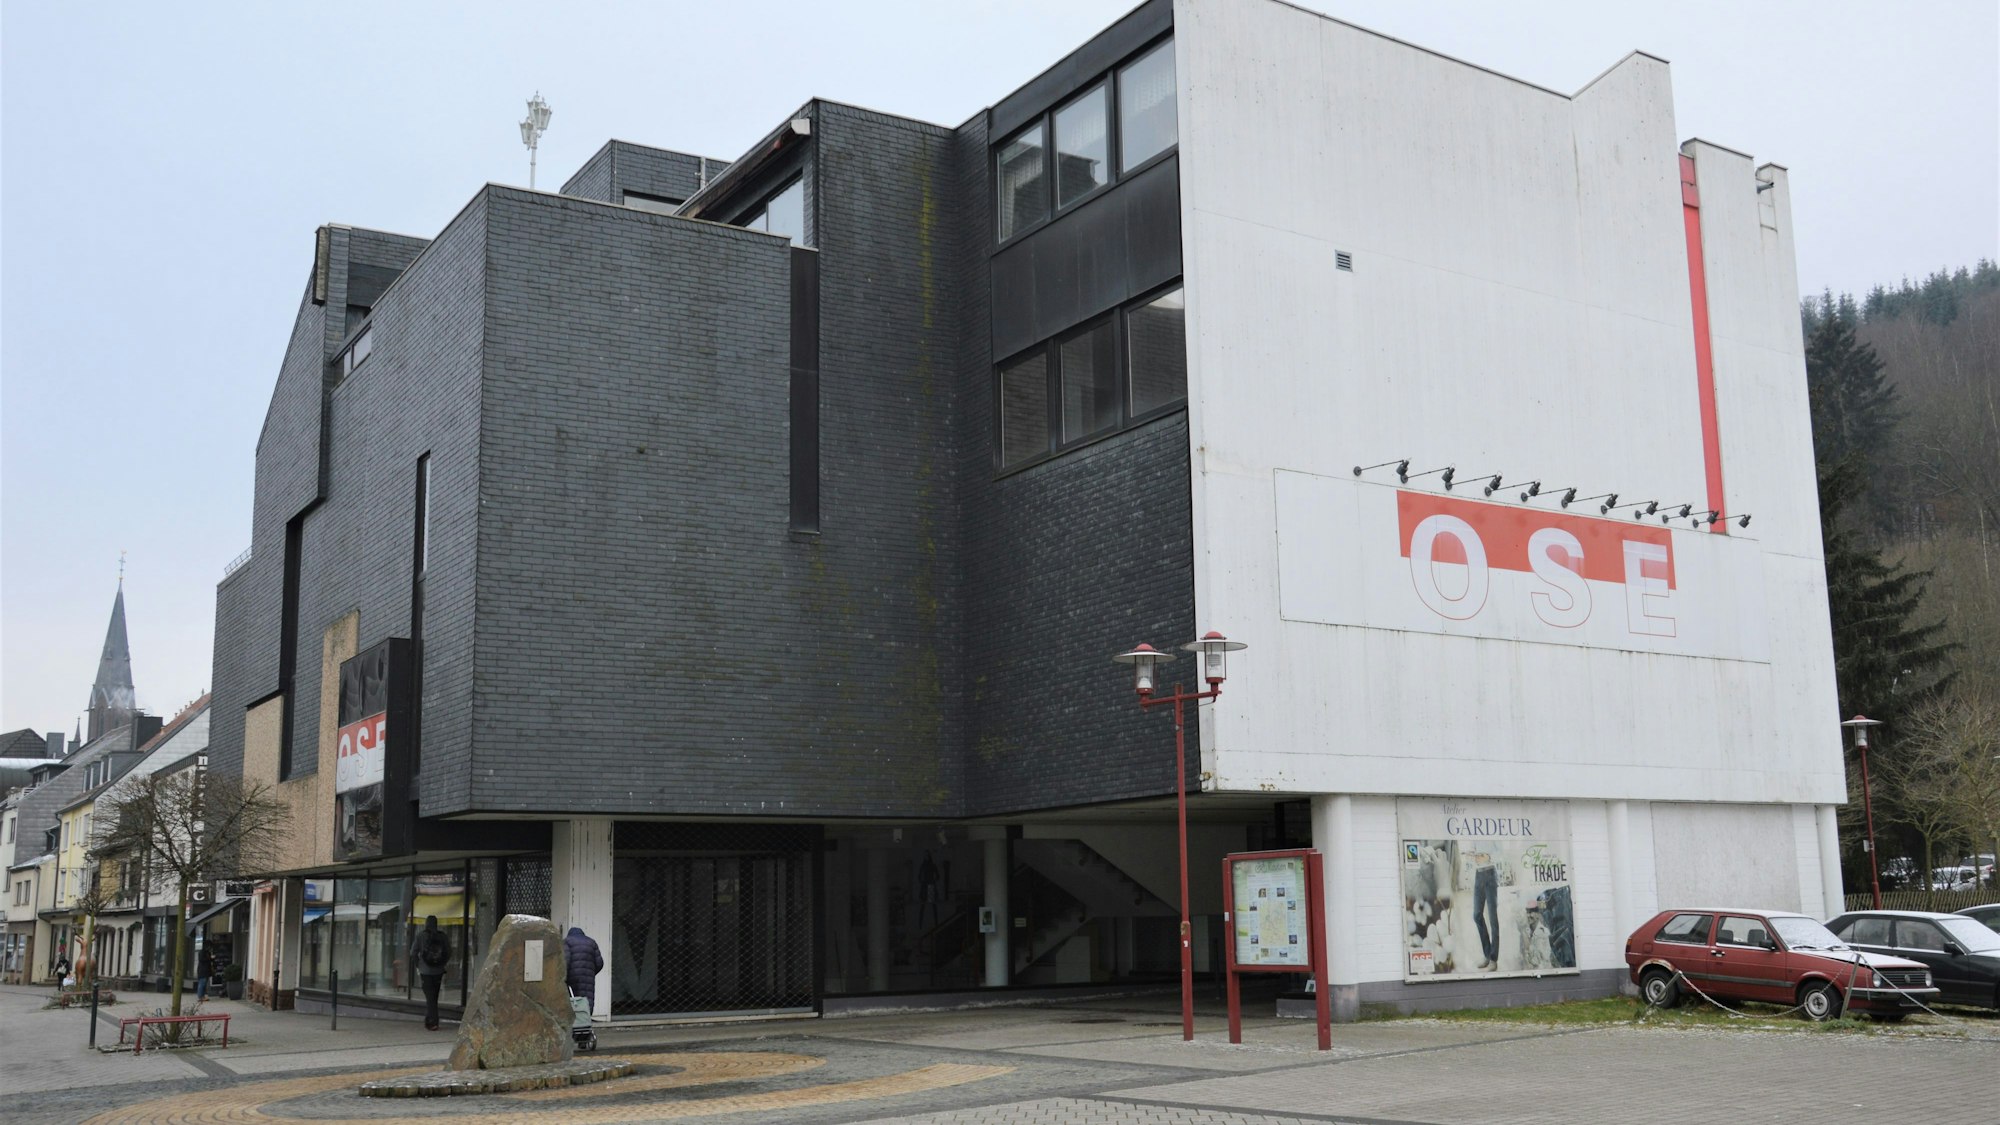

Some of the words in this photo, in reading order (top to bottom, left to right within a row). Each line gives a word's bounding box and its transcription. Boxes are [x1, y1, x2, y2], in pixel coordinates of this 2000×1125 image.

[1410, 514, 1676, 637] OSE
[338, 719, 386, 782] OSE
[1446, 817, 1532, 836] GARDEUR
[1533, 864, 1567, 882] TRADE
